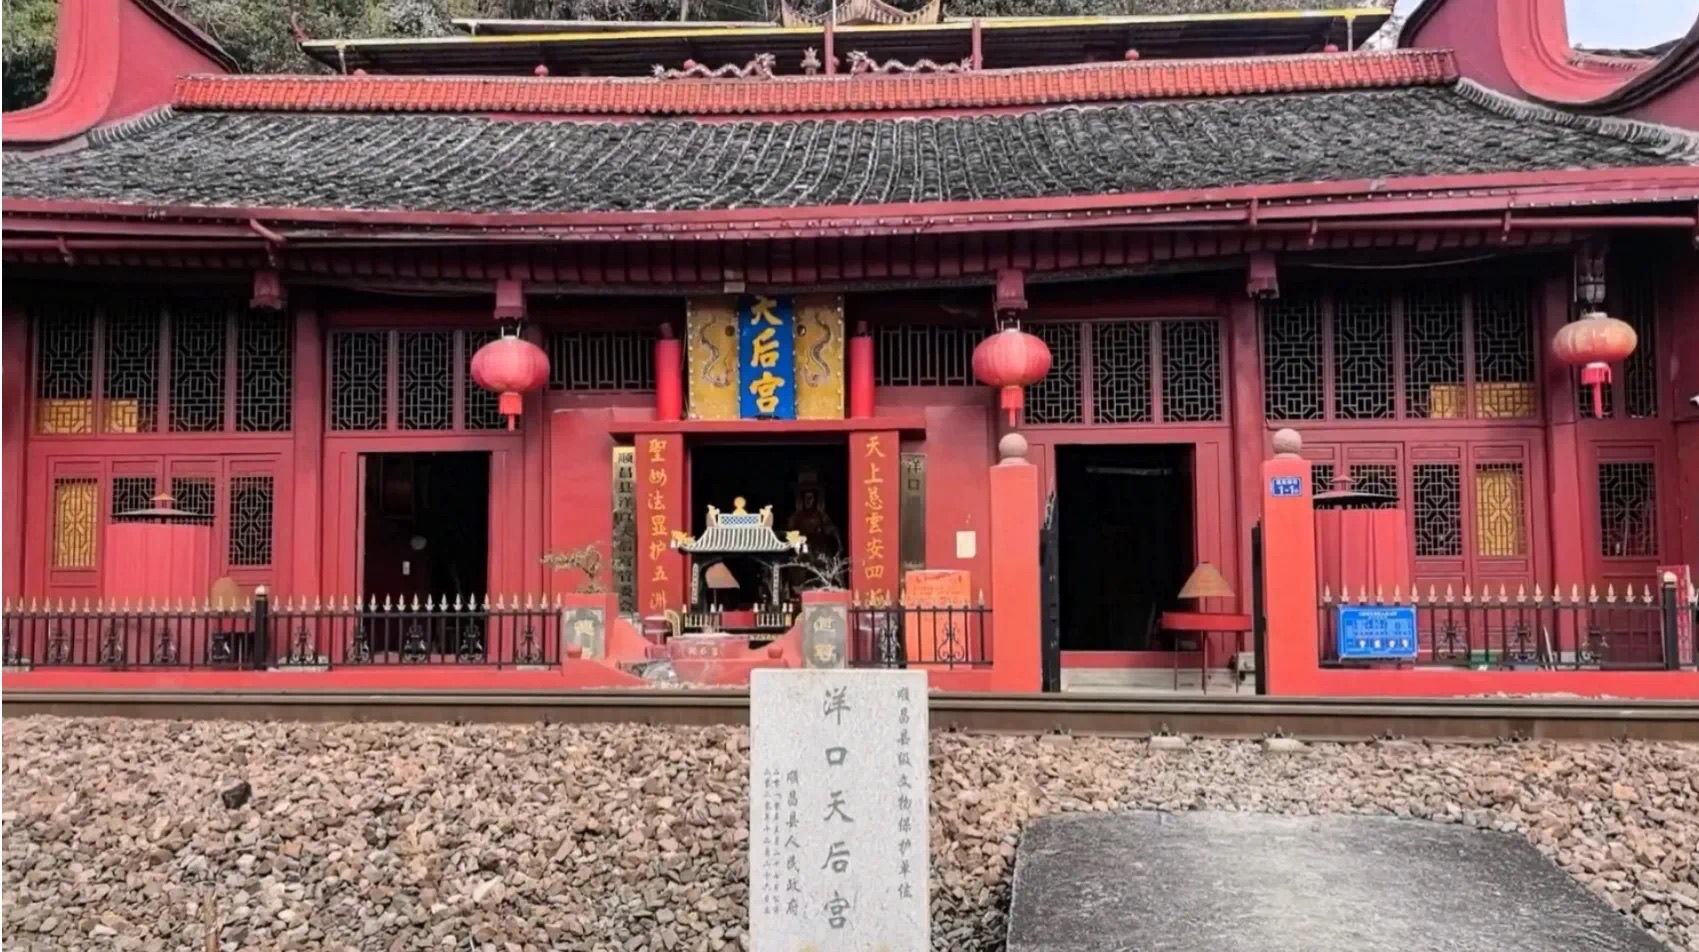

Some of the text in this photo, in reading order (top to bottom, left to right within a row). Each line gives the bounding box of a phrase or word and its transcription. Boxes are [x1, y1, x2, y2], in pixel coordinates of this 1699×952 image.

[750, 296, 785, 413] 天后宫
[785, 769, 800, 917] 顺昌县人民政府
[821, 686, 853, 929] 洋口天后宫
